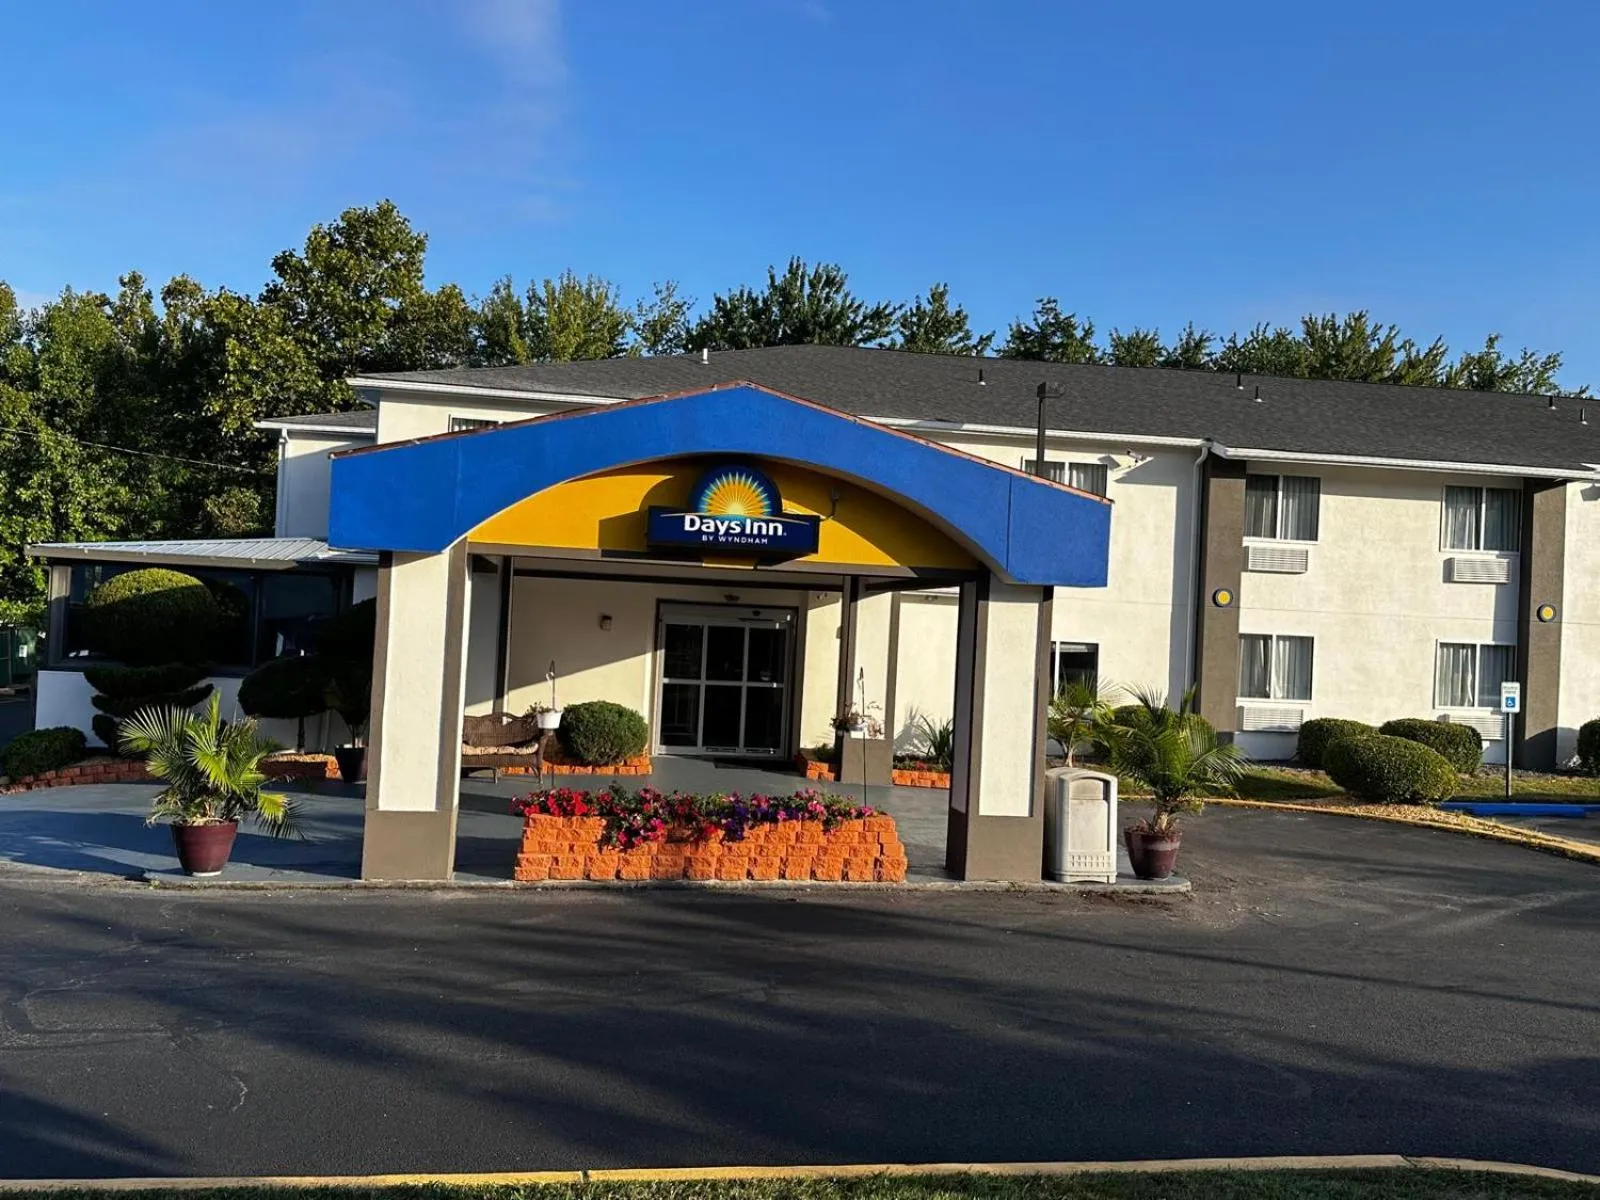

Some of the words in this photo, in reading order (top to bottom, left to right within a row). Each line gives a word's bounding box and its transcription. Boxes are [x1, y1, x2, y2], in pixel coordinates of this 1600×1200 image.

[684, 515, 741, 535] Days
[745, 518, 783, 536] Inn
[718, 536, 768, 544] WYNDHAM
